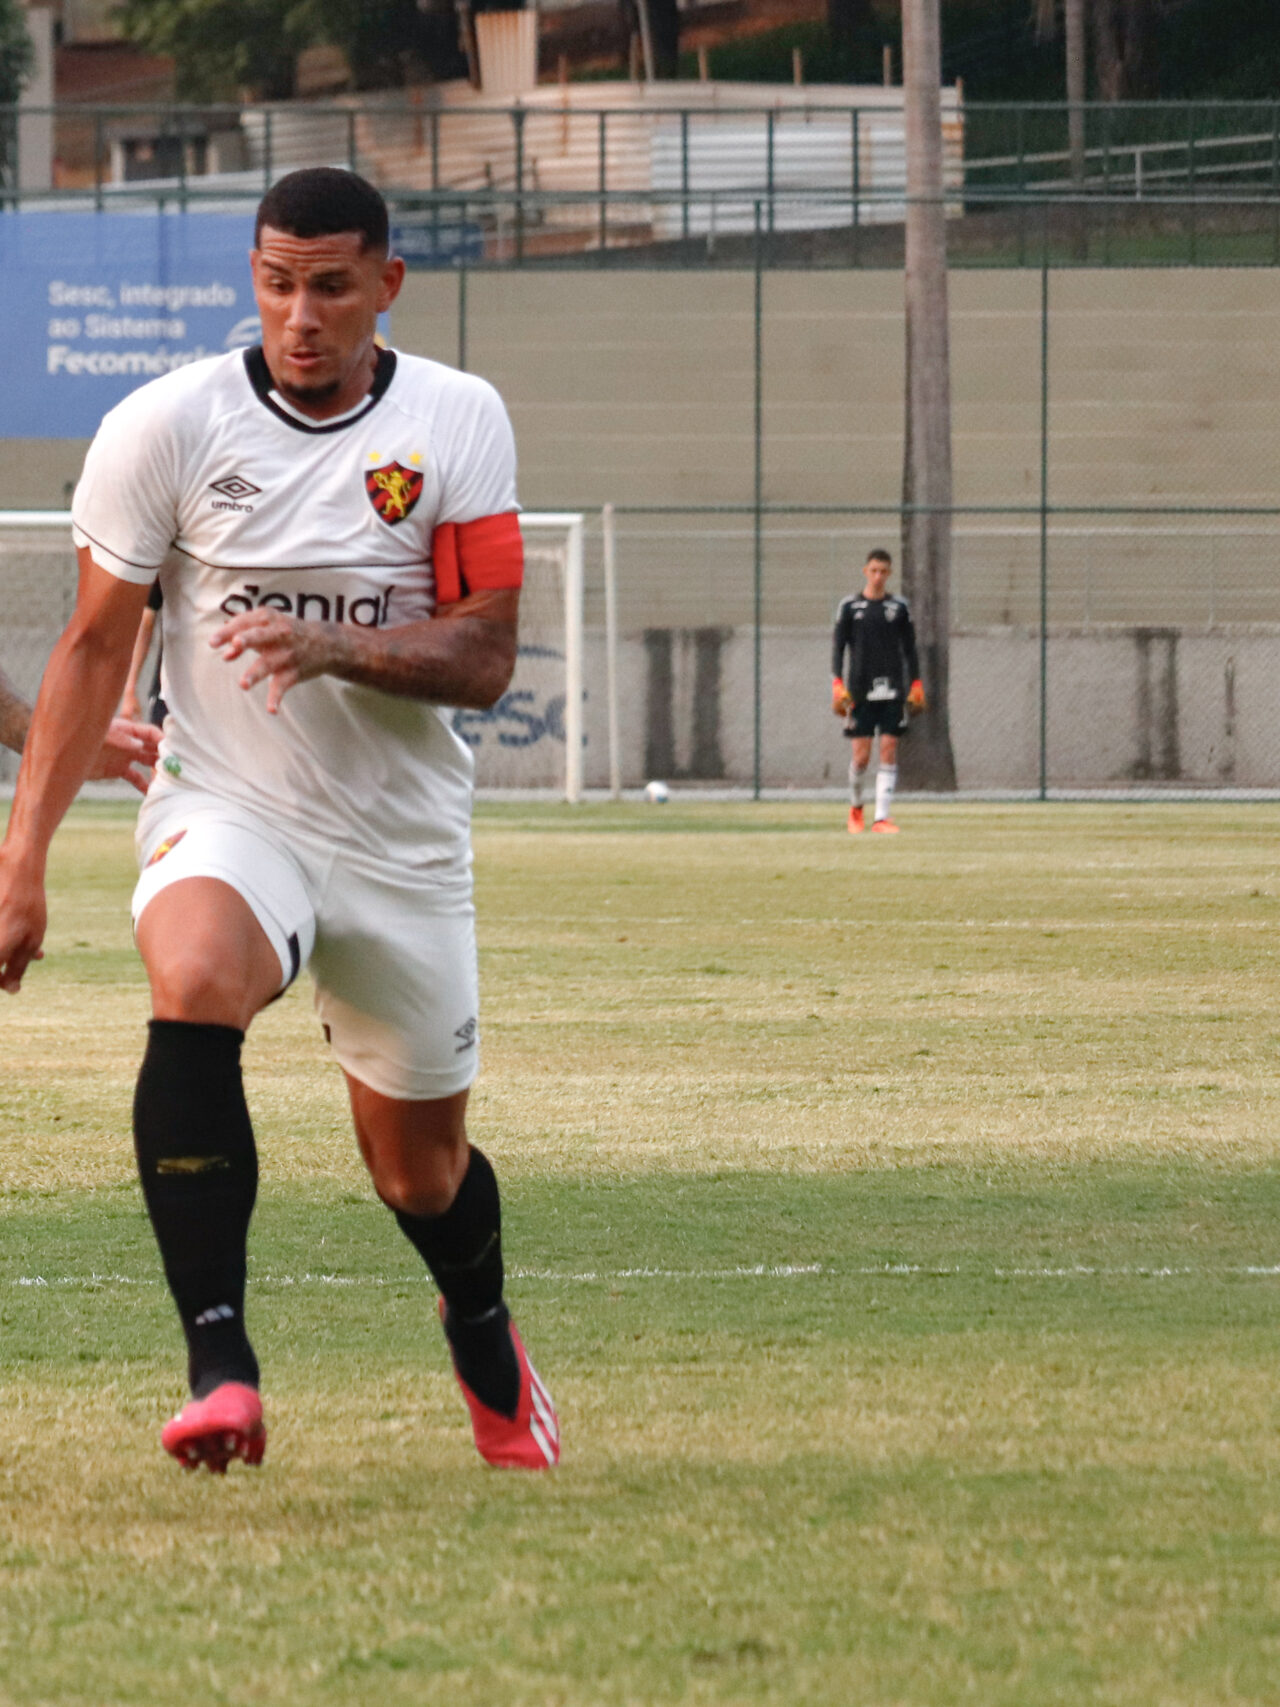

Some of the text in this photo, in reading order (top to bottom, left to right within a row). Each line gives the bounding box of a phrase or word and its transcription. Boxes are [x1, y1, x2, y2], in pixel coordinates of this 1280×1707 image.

[120, 281, 237, 312] integrado
[48, 314, 187, 339] ao Sistema
[211, 500, 253, 513] umbro
